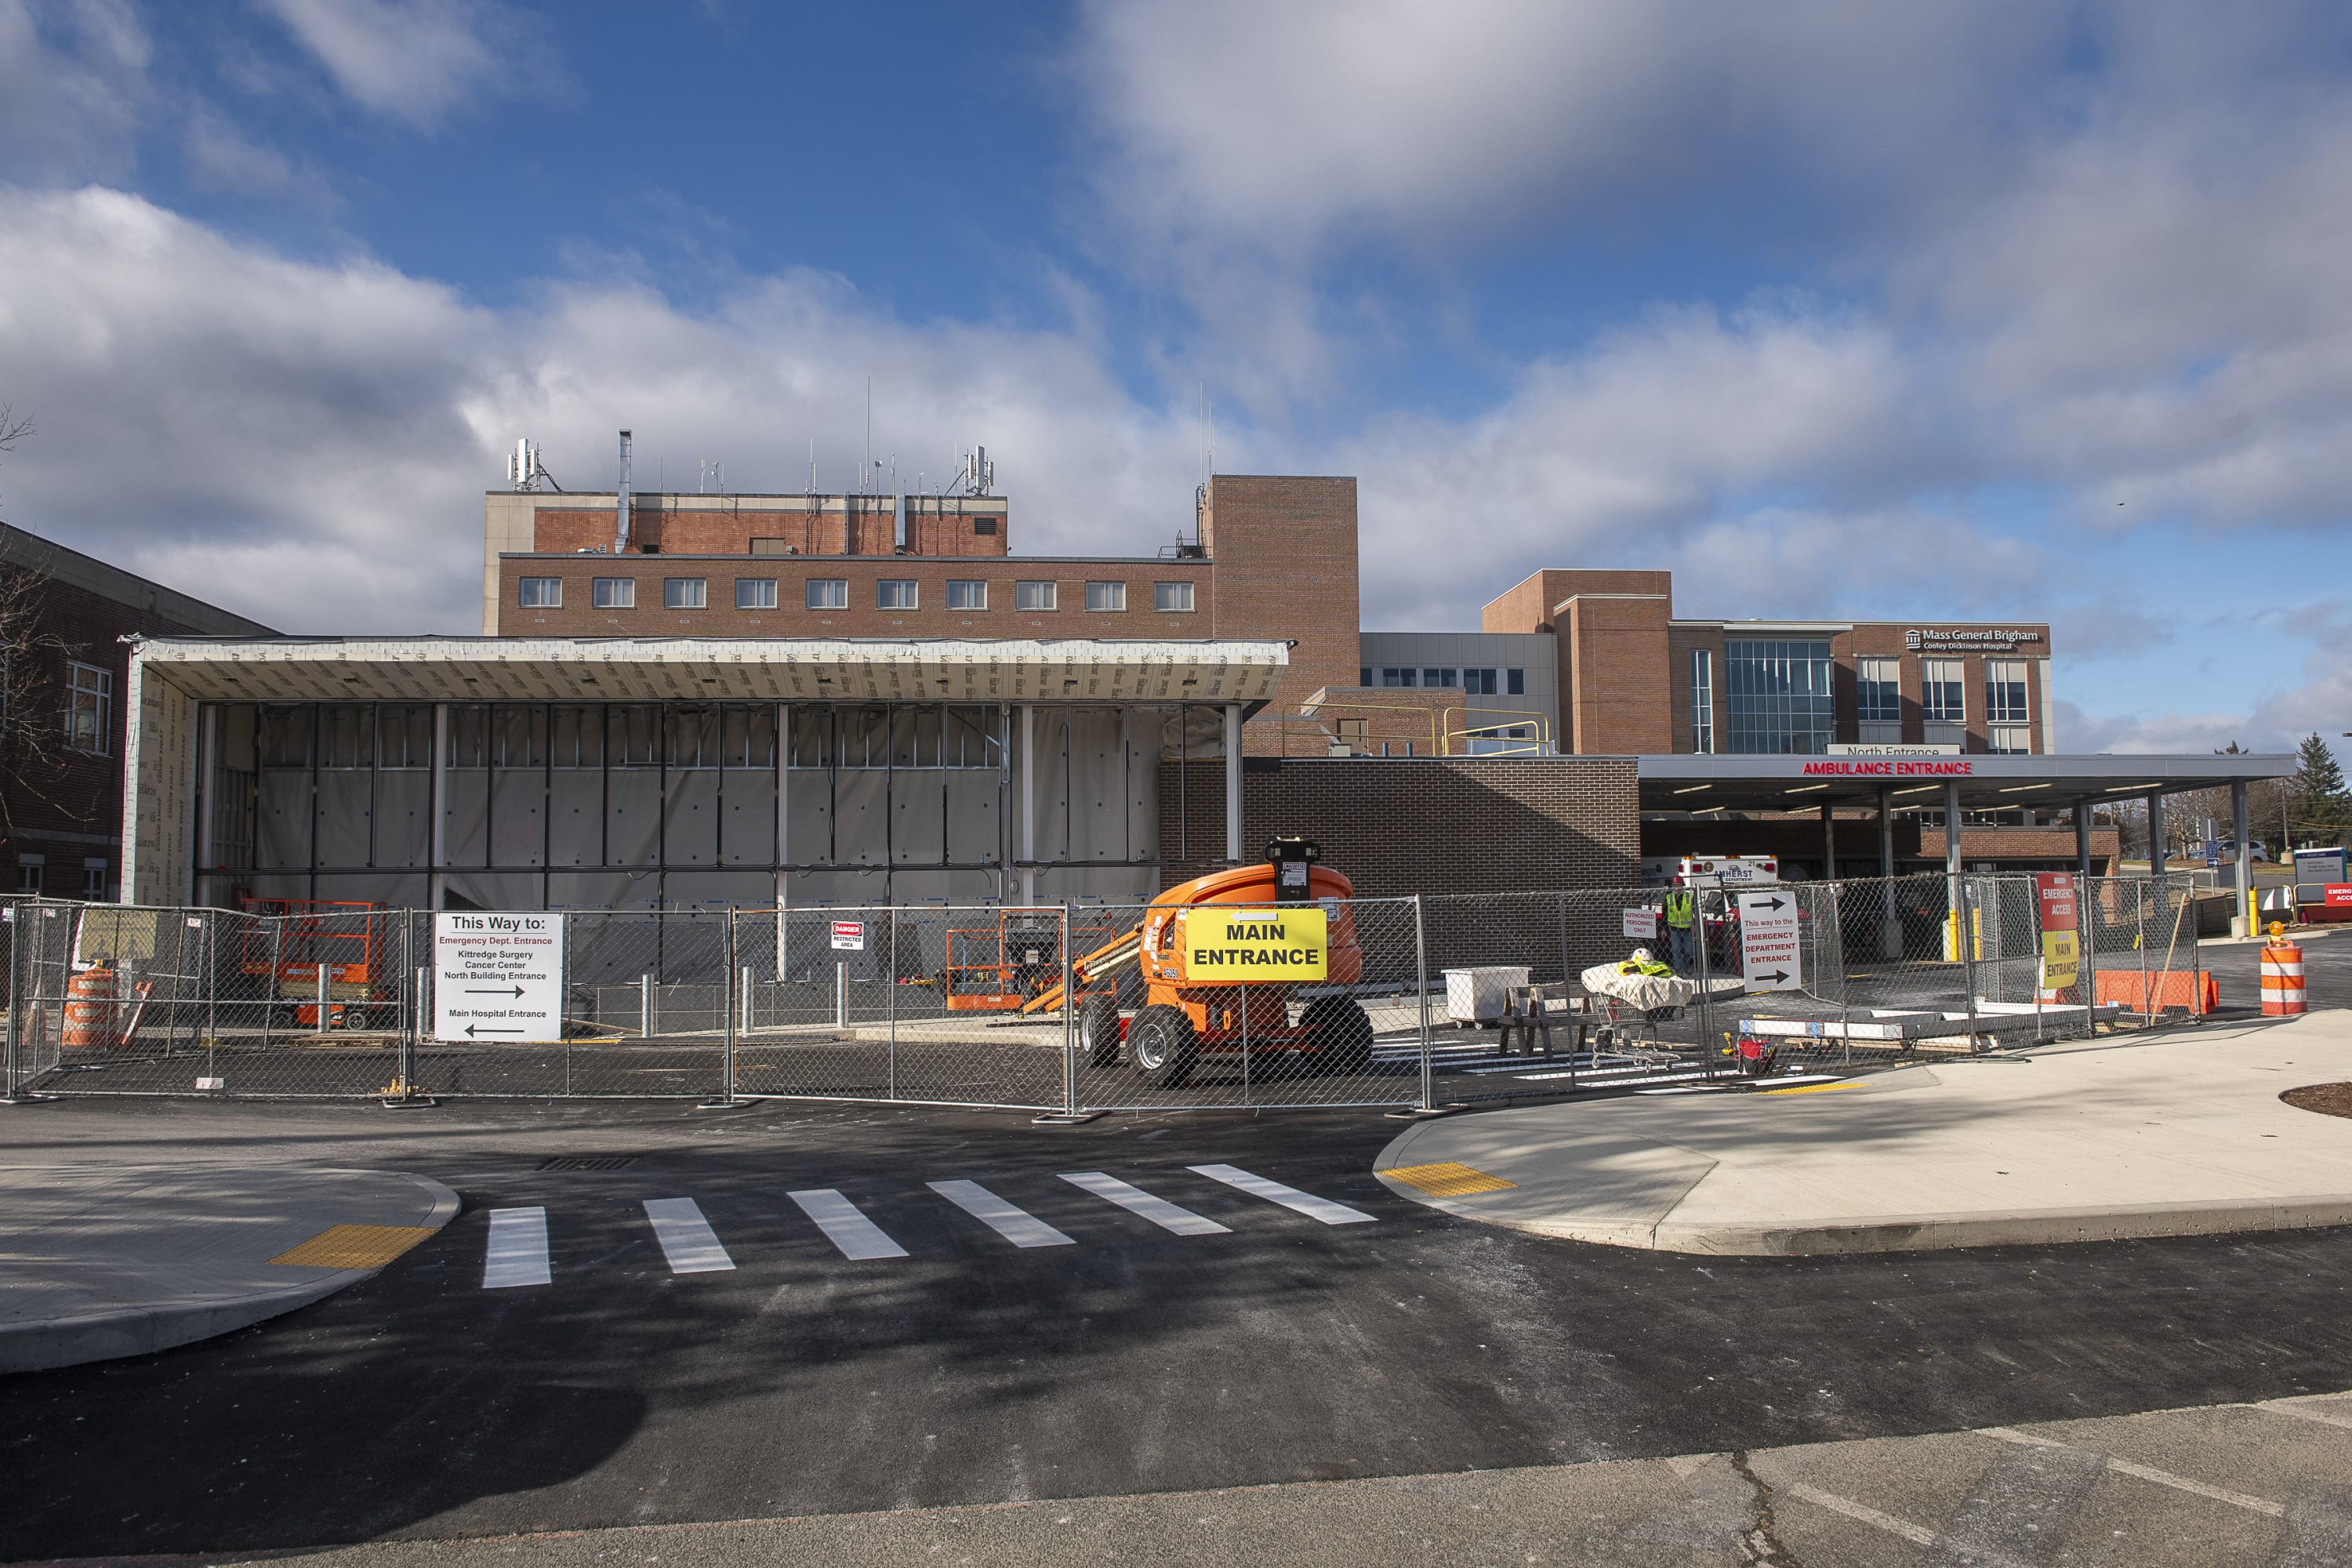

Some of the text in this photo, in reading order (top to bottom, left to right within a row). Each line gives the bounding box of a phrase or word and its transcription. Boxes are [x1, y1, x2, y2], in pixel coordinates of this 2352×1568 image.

[1922, 630, 2038, 642] Mass General Brigham
[1983, 642, 2012, 651] Hospital
[1802, 762, 1972, 775] AMBULANCE ENTRANCE
[2042, 888, 2073, 899] EMERGENCY
[2052, 904, 2071, 915] ACCESS
[452, 916, 546, 931] This Way to:
[1226, 924, 1285, 940] MAIN
[1746, 932, 1794, 941] EMERGENCY
[439, 937, 487, 946] Emergency
[489, 937, 511, 946] Dept.
[1745, 943, 1796, 953] DEPARTMENT
[2055, 943, 2071, 956] MAIN
[458, 950, 533, 960] Kittredge Surgery
[1194, 949, 1319, 965] ENTRANCE
[1751, 954, 1792, 964] ENTRANCE
[2047, 961, 2077, 977] ENTRANCE
[470, 972, 506, 981] Building
[471, 1010, 506, 1019] Hospital
